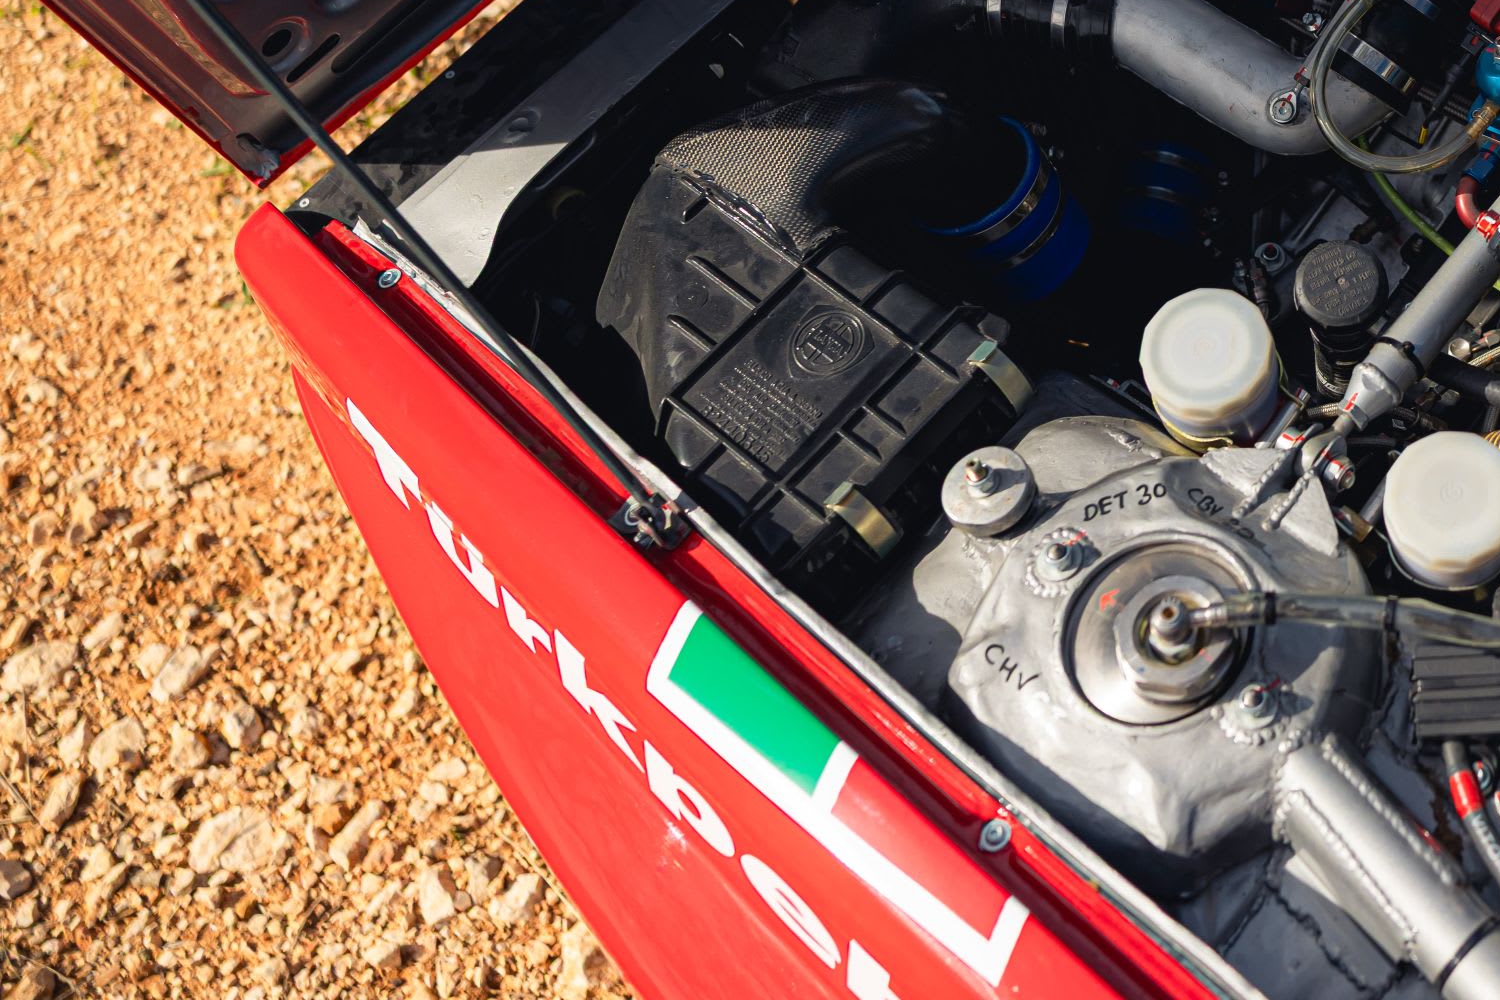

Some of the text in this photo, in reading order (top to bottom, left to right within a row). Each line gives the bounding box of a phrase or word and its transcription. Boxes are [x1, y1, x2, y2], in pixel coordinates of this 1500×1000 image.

[1083, 482, 1168, 522] DET 30
[984, 643, 1041, 691] CHV
